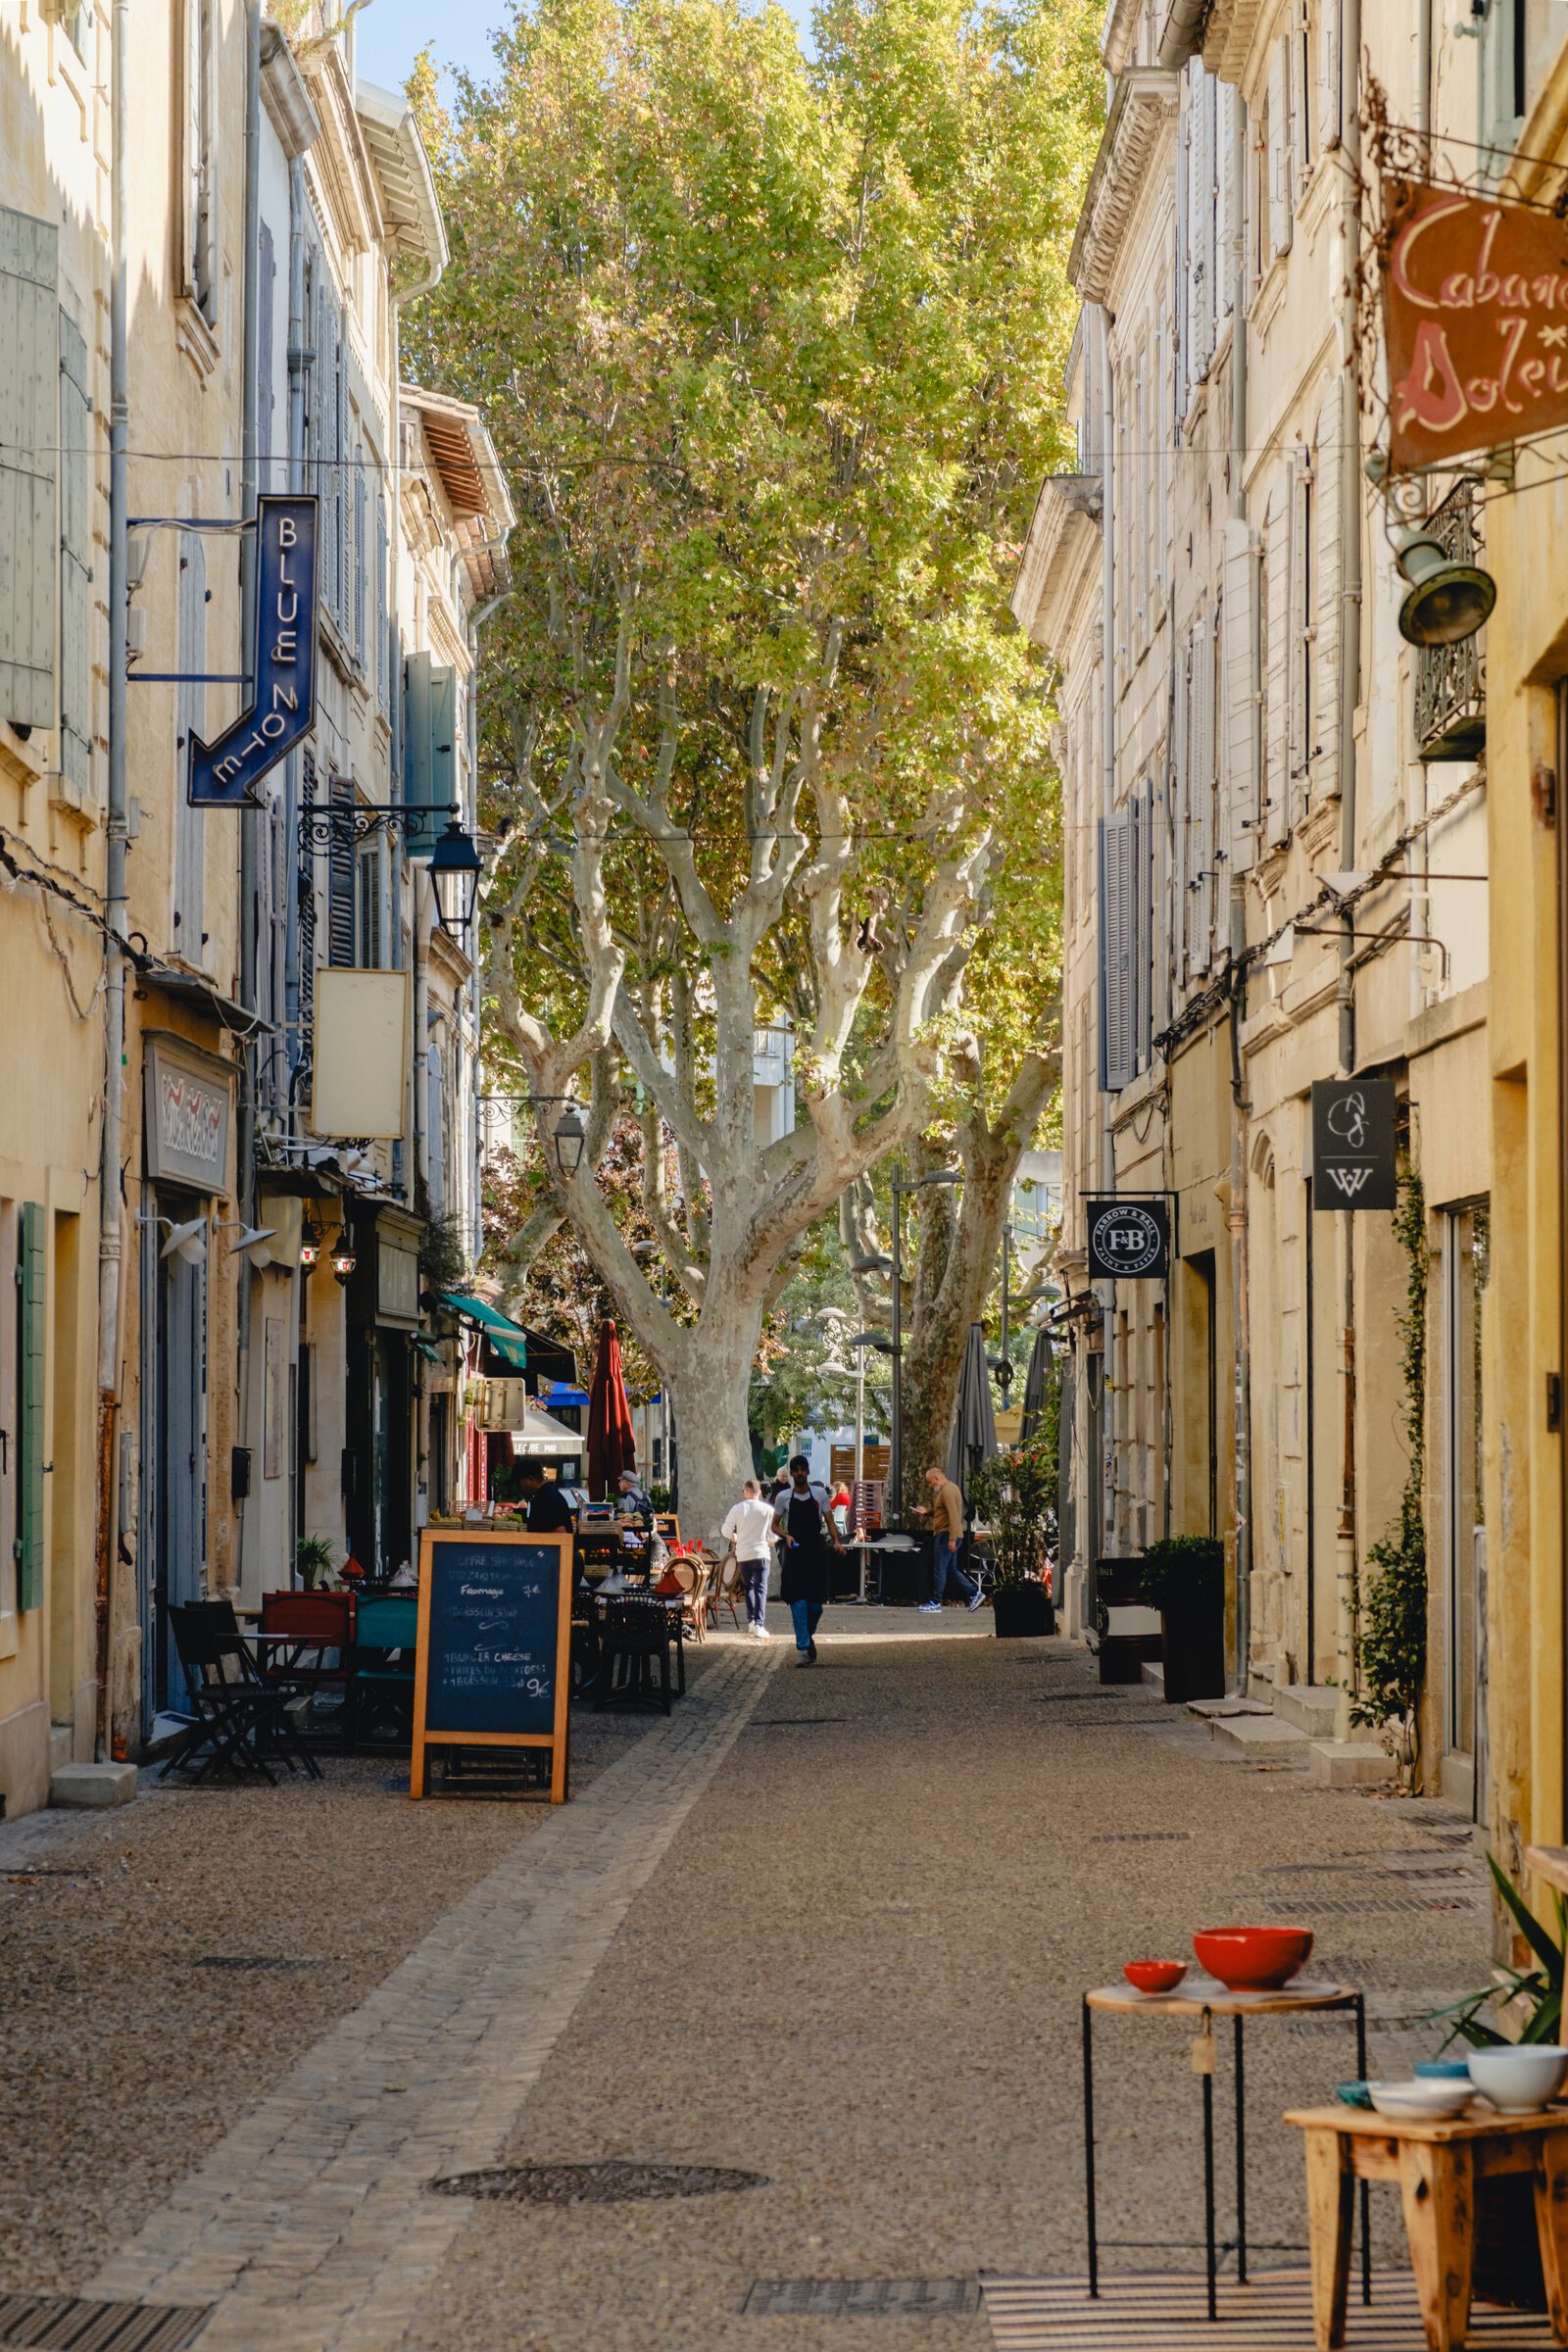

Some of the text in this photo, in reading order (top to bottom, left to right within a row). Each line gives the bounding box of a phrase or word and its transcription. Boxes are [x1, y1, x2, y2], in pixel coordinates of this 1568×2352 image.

[213, 517, 298, 784] BLUE NOTE
[1096, 1209, 1128, 1236] FARROW
[1139, 1214, 1155, 1236] BALL
[1108, 1229, 1145, 1250] F&B
[1097, 1247, 1119, 1268] PAINT
[1134, 1248, 1155, 1268] PAPER
